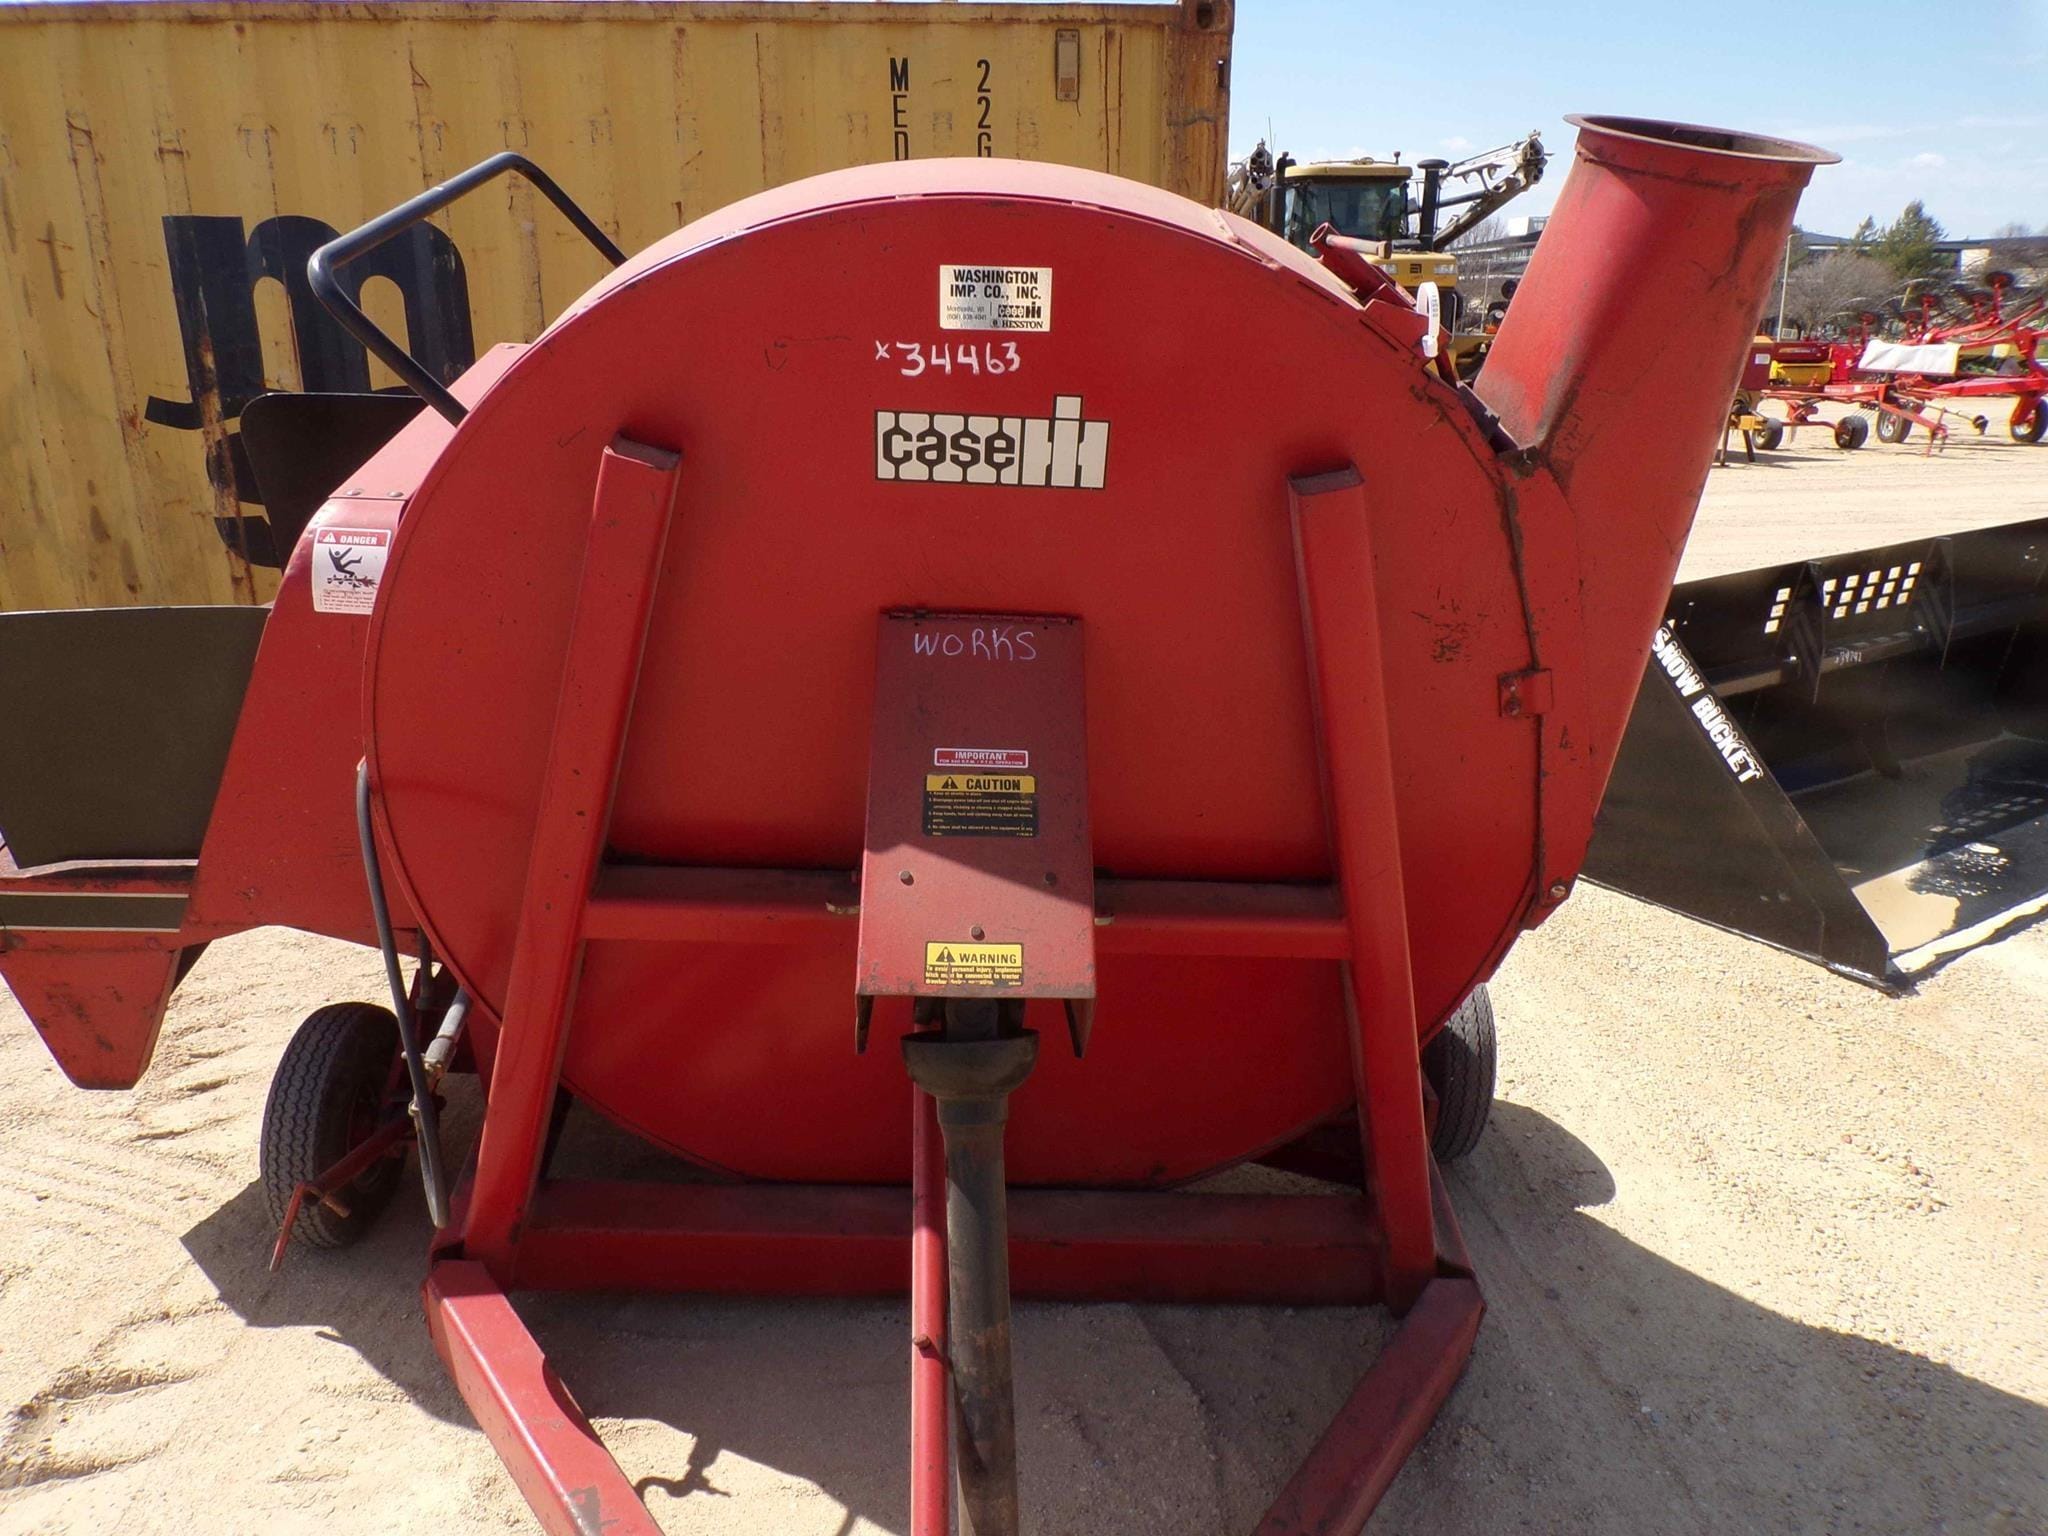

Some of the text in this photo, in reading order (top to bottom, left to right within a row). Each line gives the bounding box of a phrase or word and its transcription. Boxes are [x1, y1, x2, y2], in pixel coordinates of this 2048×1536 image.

[953, 269, 1038, 285] WASHINGTON
[950, 284, 1041, 300] IMP. CO., INC.
[1002, 320, 1043, 329] HESSTON
[340, 535, 378, 545] DANGER
[914, 625, 1037, 661] WORKS
[1652, 626, 1764, 783] SNOW BUCKET
[955, 751, 1008, 761] IMPORTANT
[966, 778, 1020, 791] CAUTION
[959, 953, 1017, 964] WARNING
